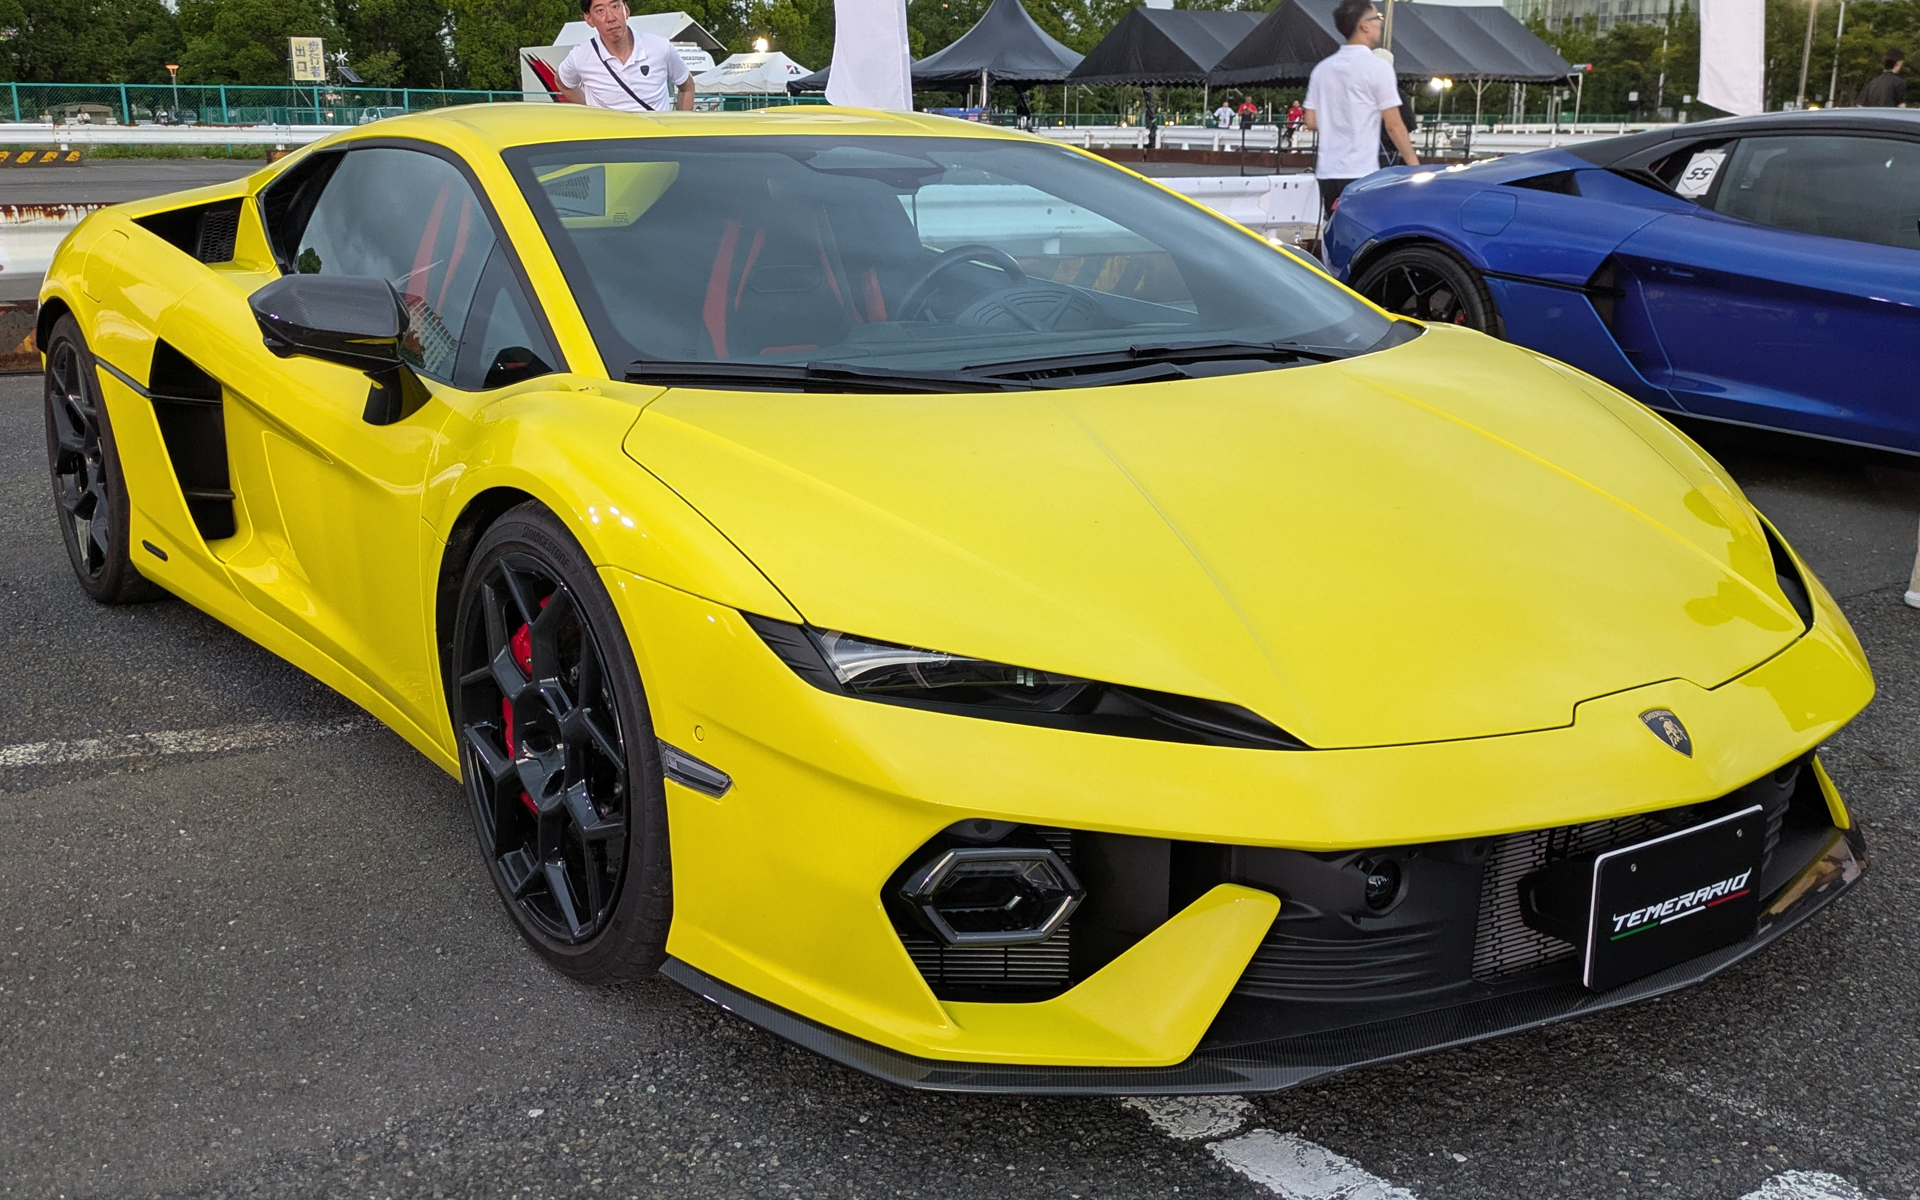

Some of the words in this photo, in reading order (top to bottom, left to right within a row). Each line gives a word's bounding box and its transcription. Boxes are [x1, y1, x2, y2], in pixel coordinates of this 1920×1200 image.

[294, 45, 307, 72] 出口
[308, 41, 321, 77] 歩行者
[521, 526, 570, 569] BRIDGESTONE
[1613, 867, 1752, 932] TEMERARIO
